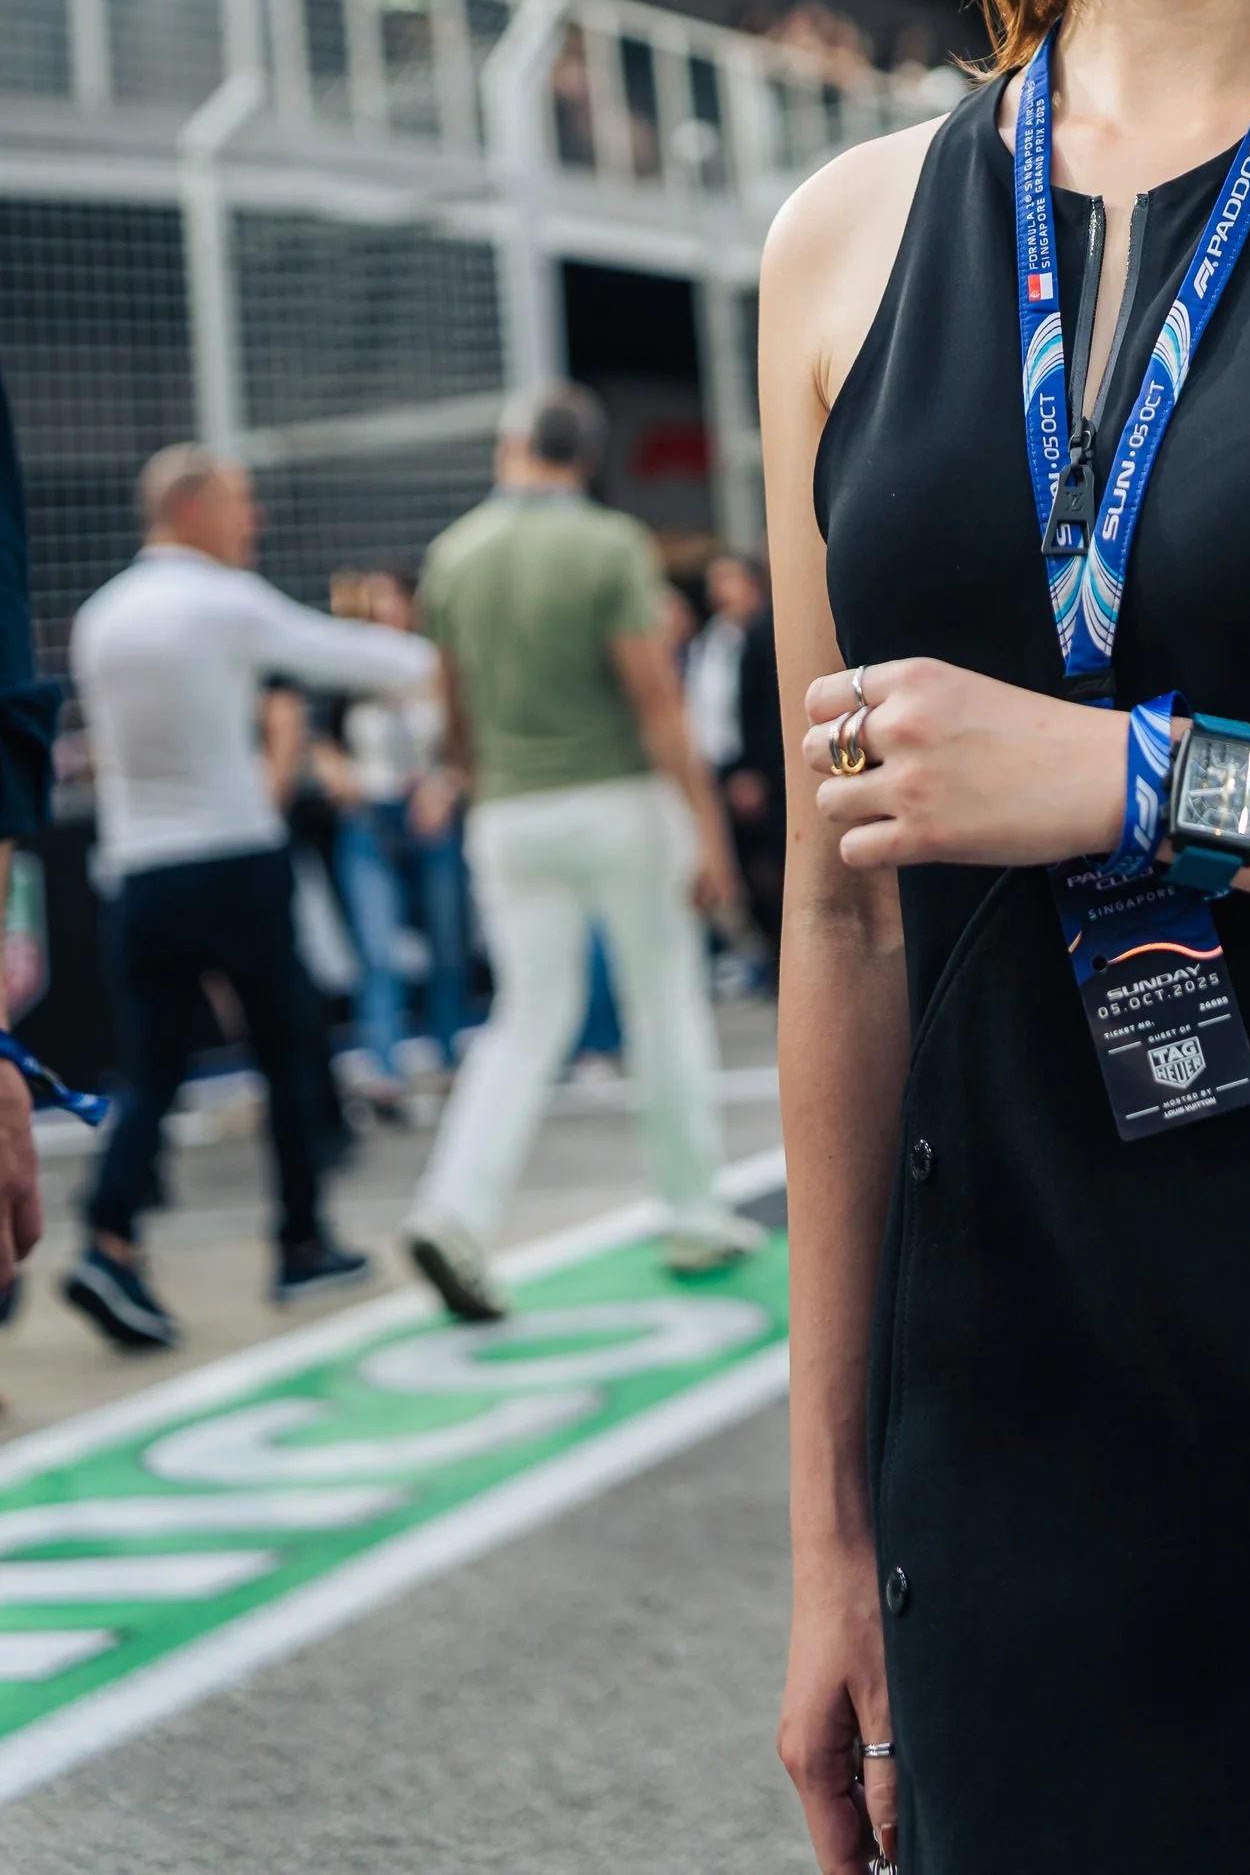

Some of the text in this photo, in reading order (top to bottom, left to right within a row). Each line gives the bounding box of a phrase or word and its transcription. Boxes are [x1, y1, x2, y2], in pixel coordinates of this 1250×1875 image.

[1024, 79, 1036, 126] AIRLINES
[1024, 129, 1034, 192] SINGAPORE
[1035, 98, 1051, 269] SINGAPORE GRAND PRIX 2025
[1026, 212, 1039, 270] FORMULA
[1039, 392, 1057, 432] OCT
[1042, 436, 1060, 460] 05
[1102, 380, 1166, 542] SUN 05 OCT
[1088, 885, 1176, 921] SINGAPORE
[1097, 972, 1220, 1019] 05.OCT.2025
[1106, 963, 1201, 1000] SUNDAY
[1104, 1024, 1135, 1039] TICKET
[1148, 1024, 1192, 1044] GUEST OF
[1153, 1039, 1196, 1065] TAG
[1156, 1057, 1203, 1084] HEUER
[1163, 1087, 1212, 1108] HOSTED BY
[1164, 1096, 1217, 1119] LOUIS VUITTON
